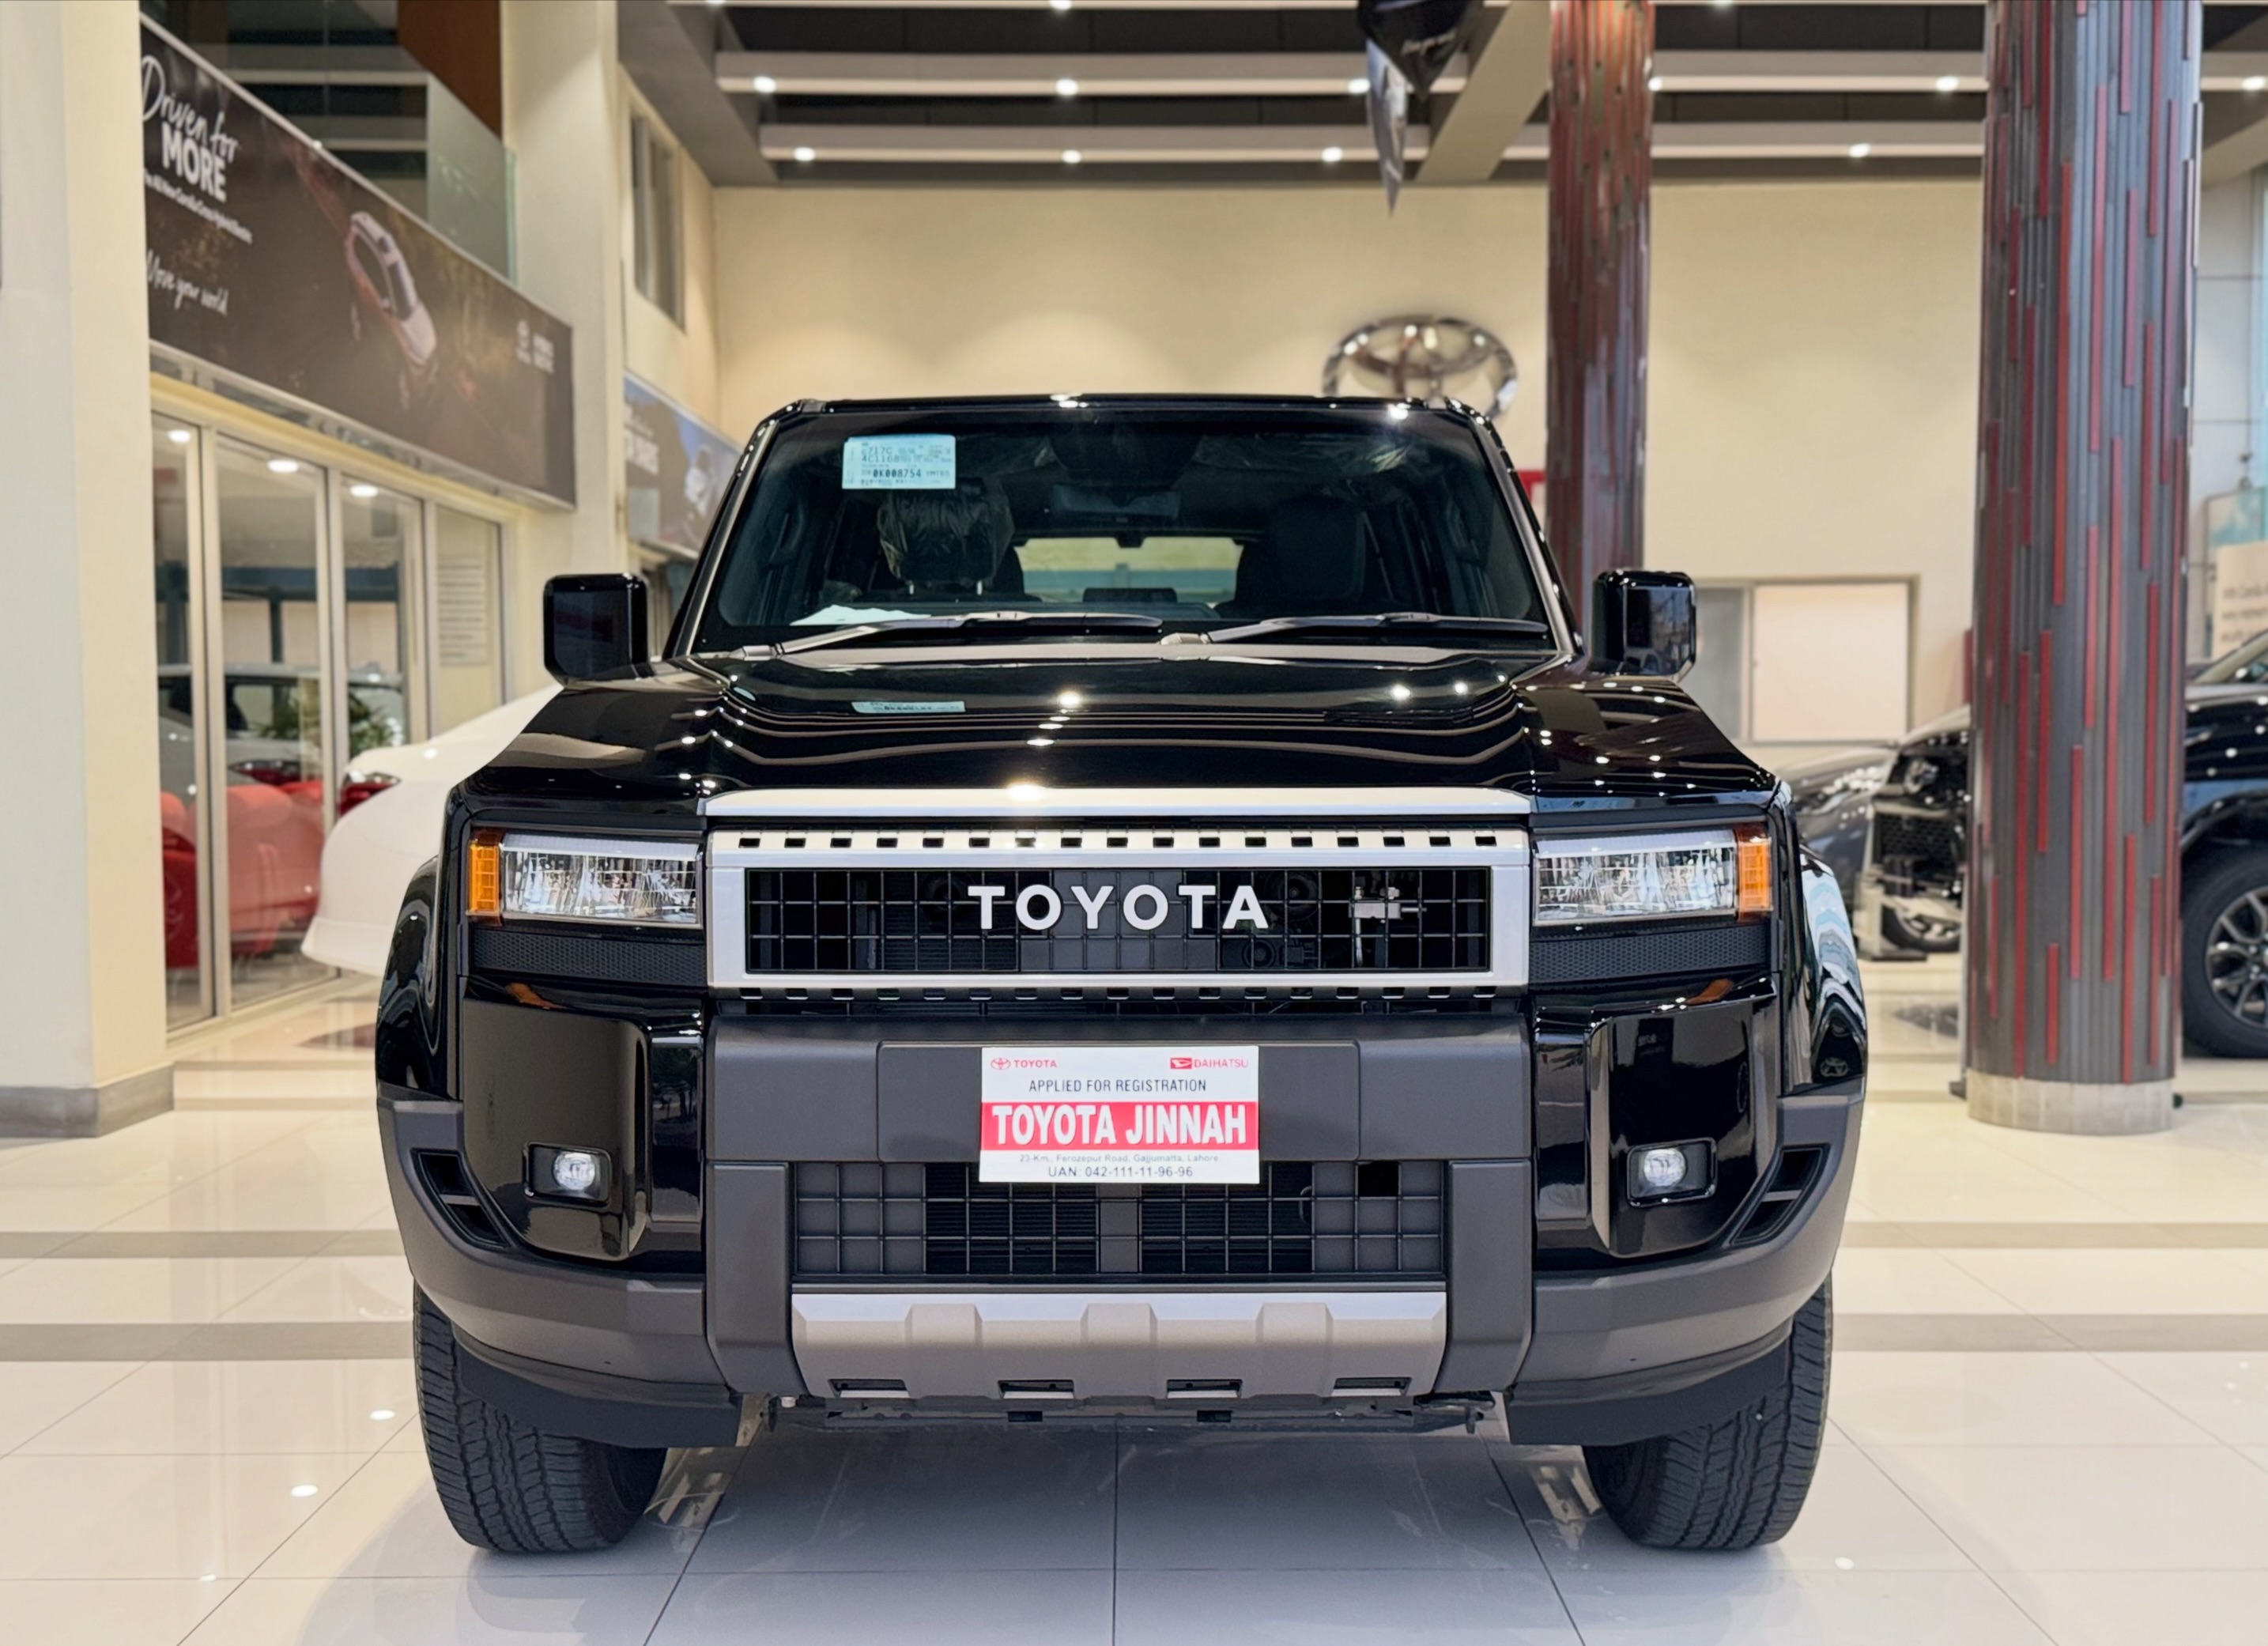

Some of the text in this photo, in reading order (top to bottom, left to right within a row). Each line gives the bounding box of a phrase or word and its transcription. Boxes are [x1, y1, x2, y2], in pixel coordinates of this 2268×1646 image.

[142, 55, 207, 145] Driven
[162, 121, 227, 203] MORE
[968, 884, 1269, 931] TOYOTA
[1194, 1059, 1248, 1068] DAIHATSU
[1029, 1079, 1206, 1092] APPLIED FOR REGISTRATION
[992, 1104, 1246, 1146] TOYOTA JINNAH
[1056, 1153, 1101, 1164] Ferozepur
[1187, 1153, 1219, 1162] Lahore
[1085, 1166, 1193, 1177] 042-111-11-96-96
